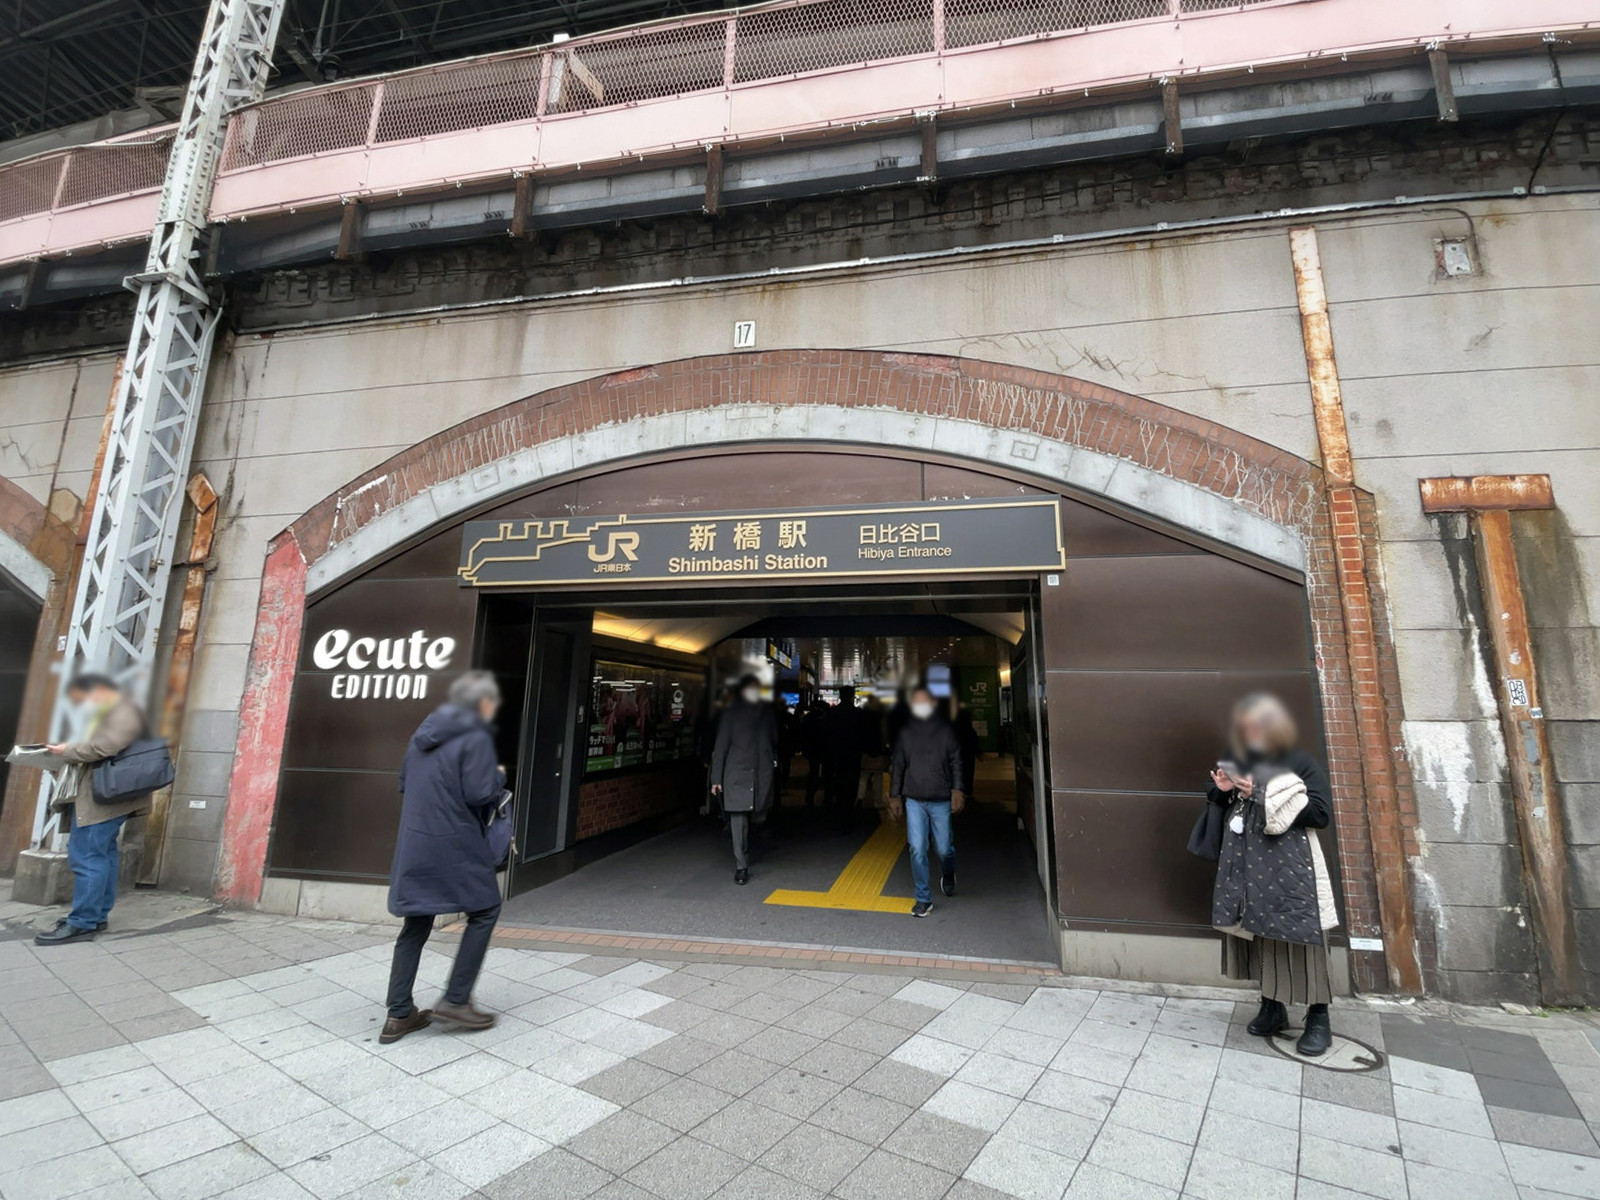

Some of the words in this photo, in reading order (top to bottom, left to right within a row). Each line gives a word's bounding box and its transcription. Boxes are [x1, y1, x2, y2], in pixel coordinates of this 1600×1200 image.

[737, 323, 752, 344] 17
[688, 520, 808, 552] 新橋駅
[859, 523, 941, 545] 日比谷口
[588, 531, 640, 563] JR
[858, 546, 895, 562] Hibiya
[897, 545, 953, 558] Entrance
[593, 563, 632, 573] JR東日本
[668, 555, 760, 574] Shimbashi
[764, 553, 829, 571] Station
[313, 629, 455, 670] ecute
[331, 674, 429, 699] EDITION
